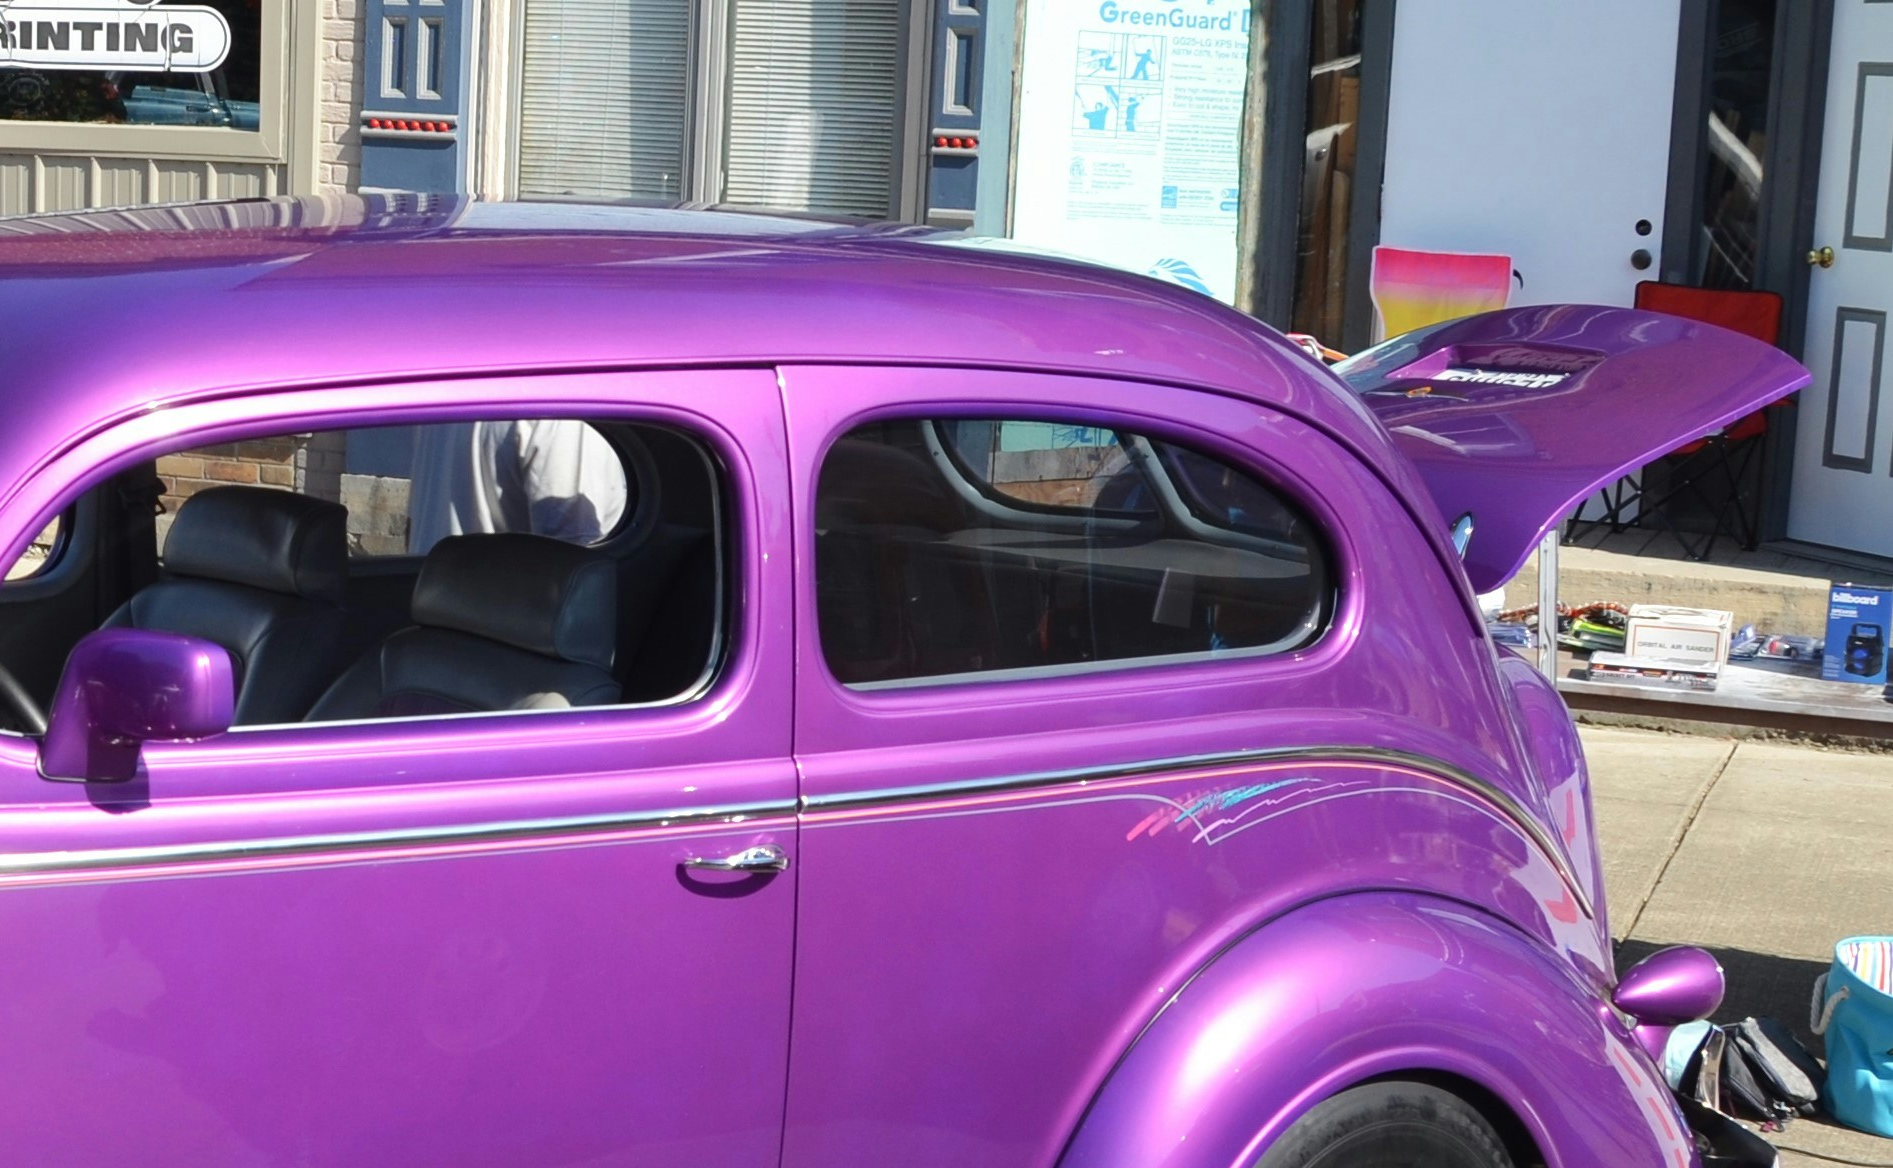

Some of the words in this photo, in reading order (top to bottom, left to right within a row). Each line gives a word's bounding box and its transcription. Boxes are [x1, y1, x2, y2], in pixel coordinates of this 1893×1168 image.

[1215, 38, 1232, 49] XPS
[1832, 592, 1879, 605] billboard
[1637, 641, 1668, 649] ORBITAL
[1685, 645, 1714, 653] SANDER
